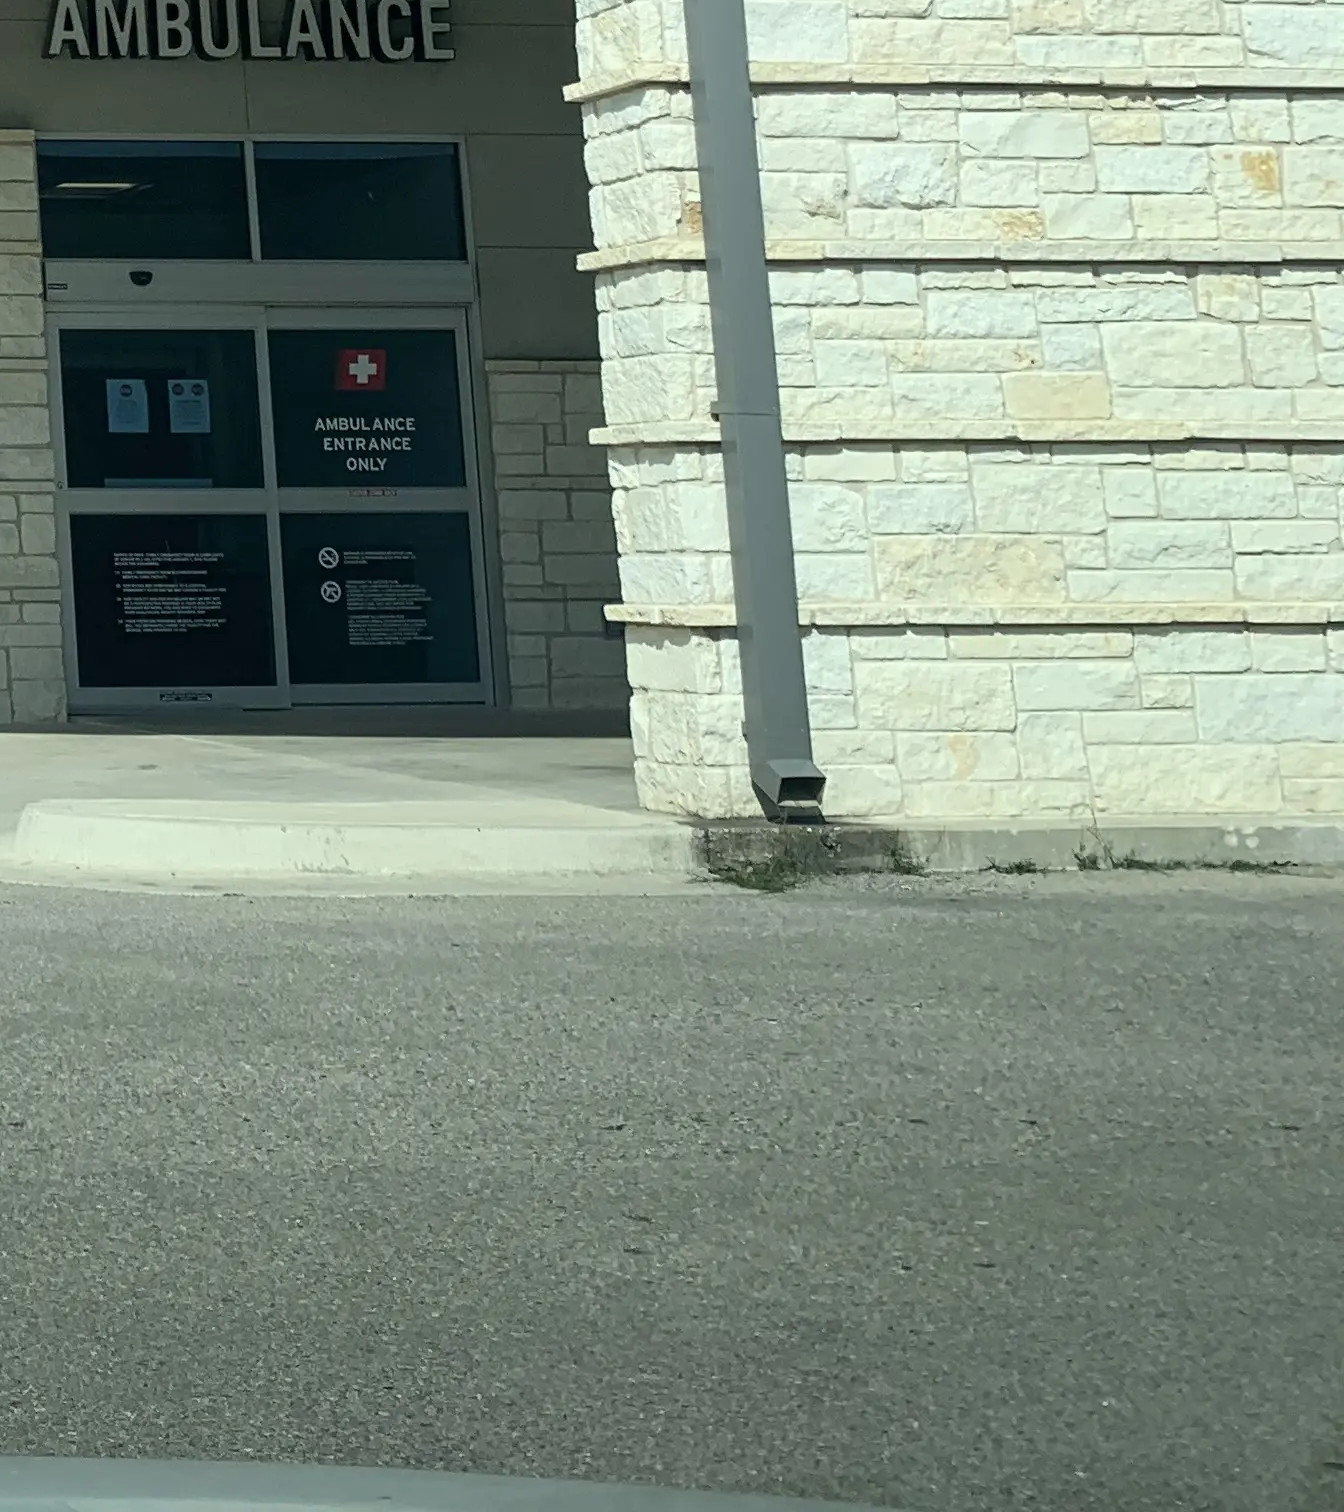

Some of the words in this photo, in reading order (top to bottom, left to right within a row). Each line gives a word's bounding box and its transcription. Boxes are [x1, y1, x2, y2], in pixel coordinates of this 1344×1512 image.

[314, 417, 416, 431] AMBULANCE
[323, 437, 412, 451] ENTRANCE
[346, 457, 388, 471] ONLY
